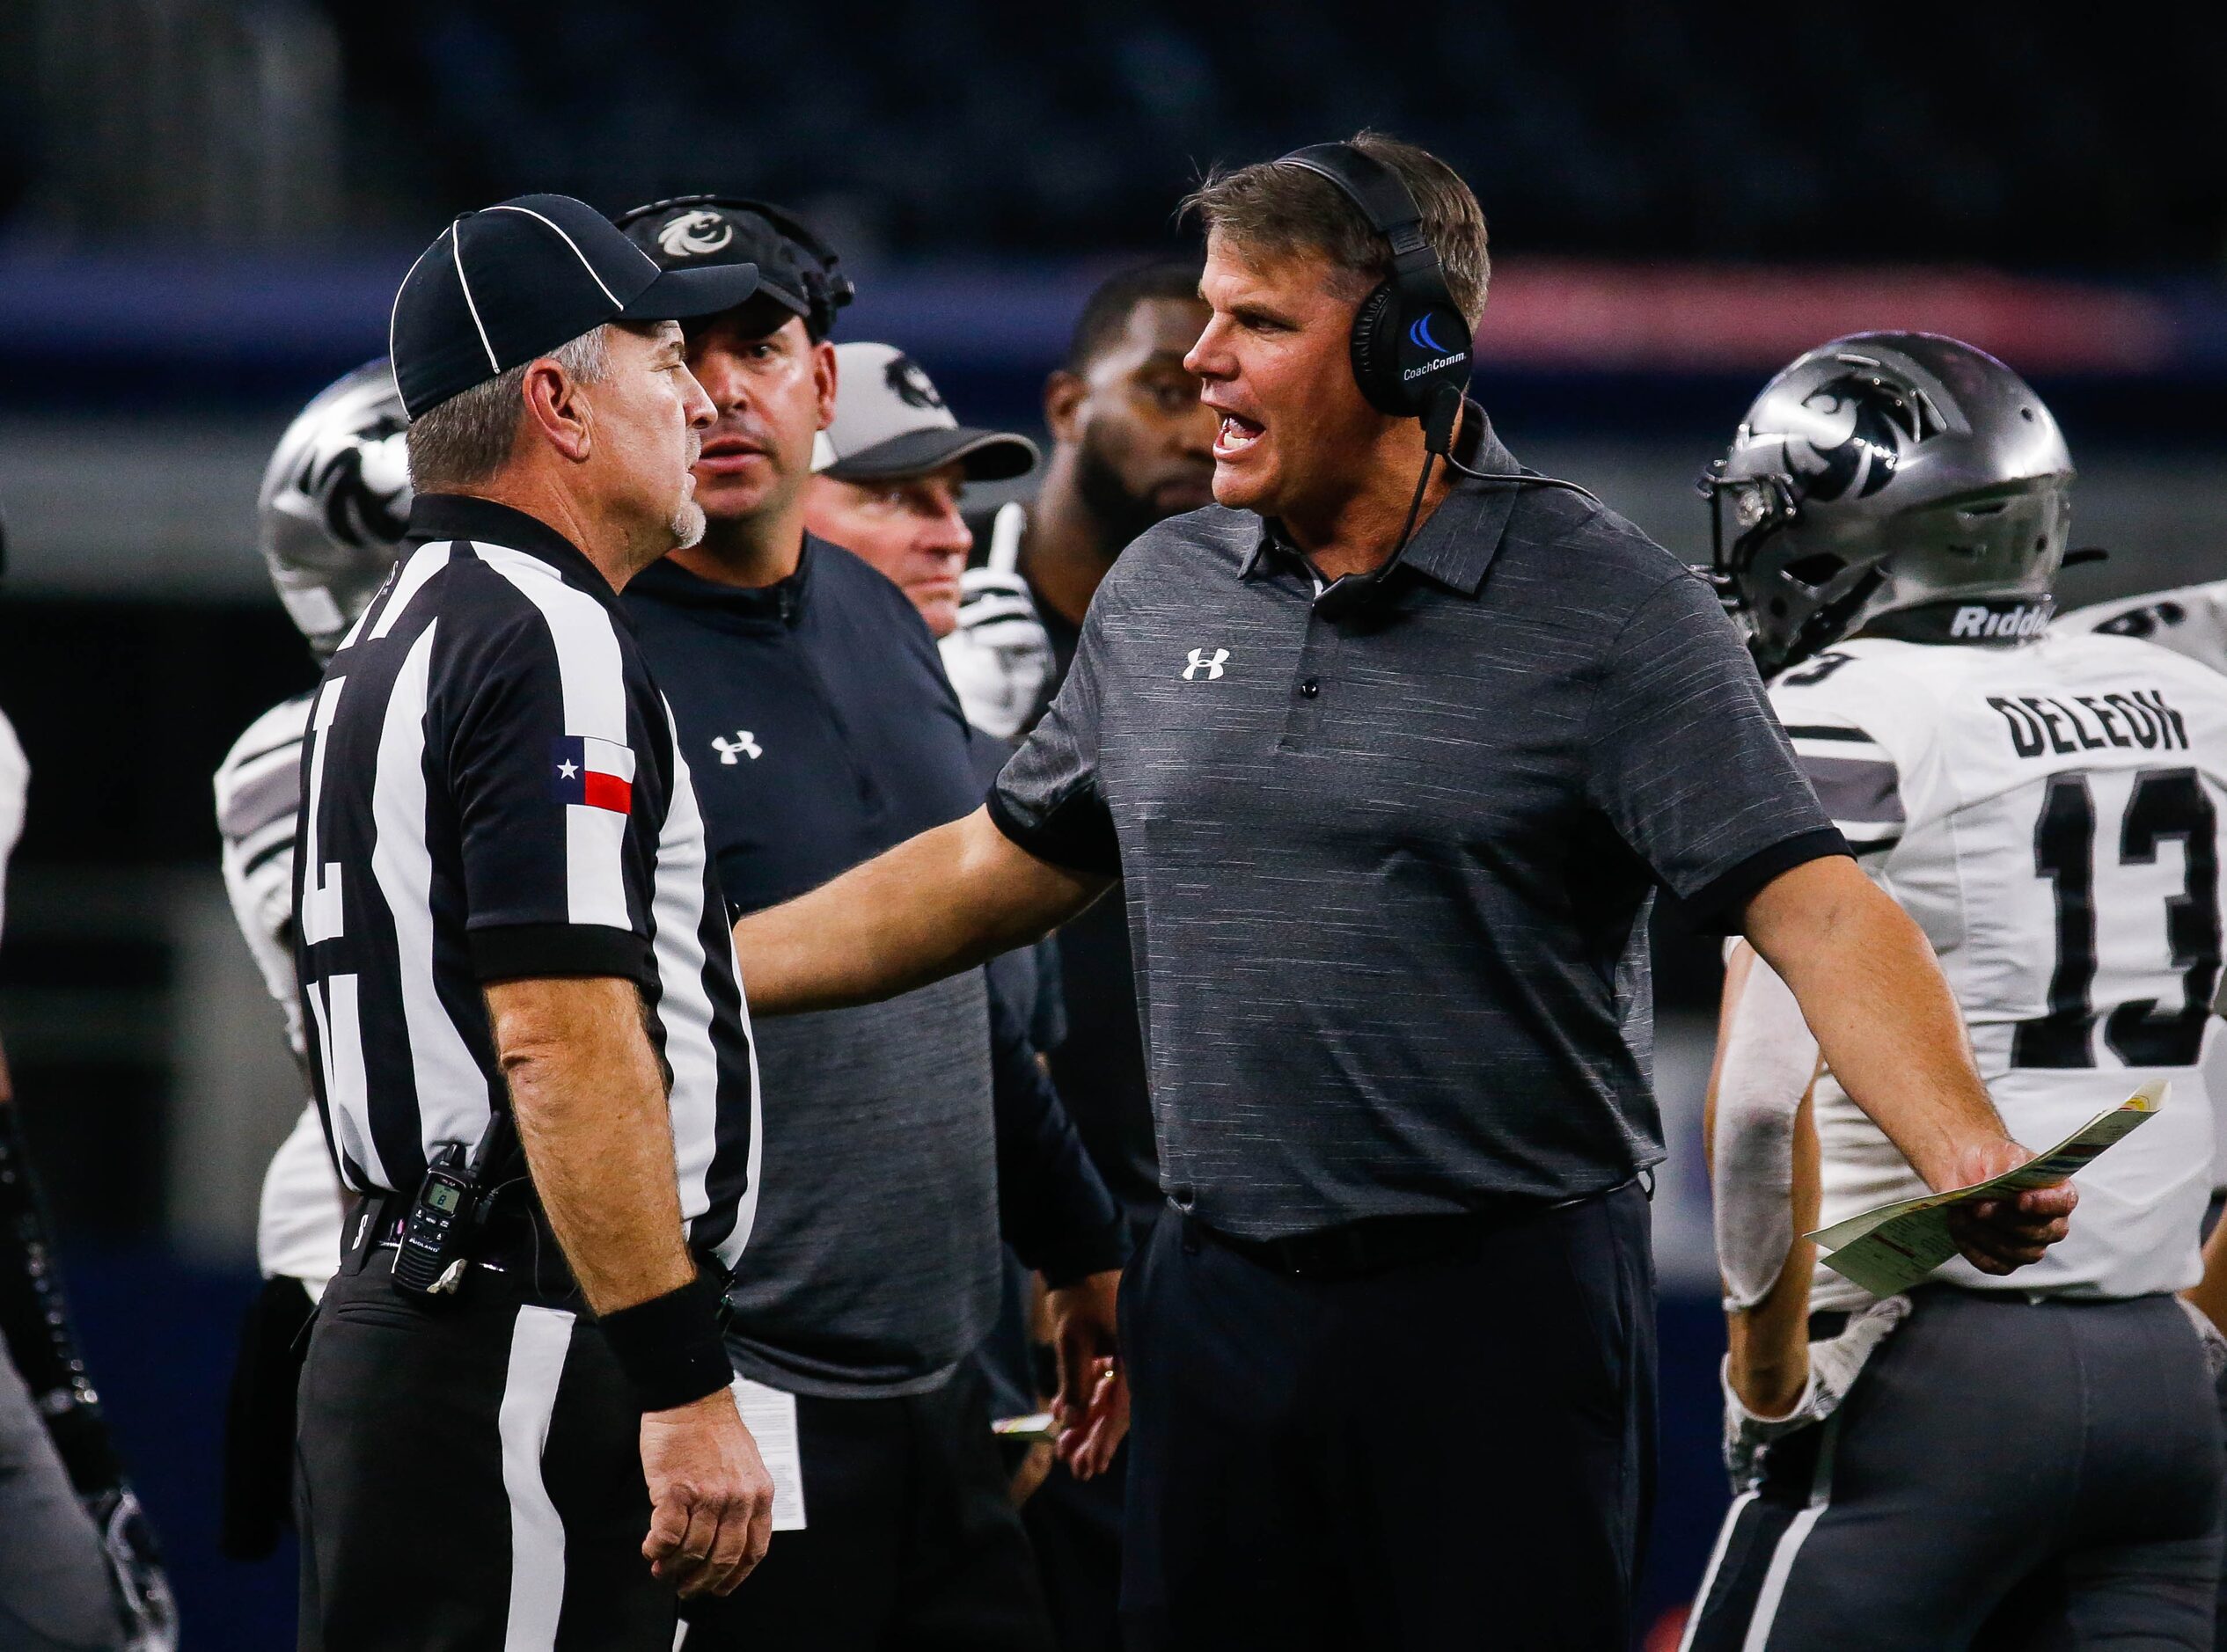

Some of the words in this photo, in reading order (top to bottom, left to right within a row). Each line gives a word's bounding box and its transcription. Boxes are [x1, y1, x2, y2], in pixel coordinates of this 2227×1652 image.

[1403, 352, 1465, 381] CoachComm
[1950, 604, 2057, 637] Ridd
[1986, 691, 2189, 757] DELEON
[2010, 766, 2223, 1068] 13
